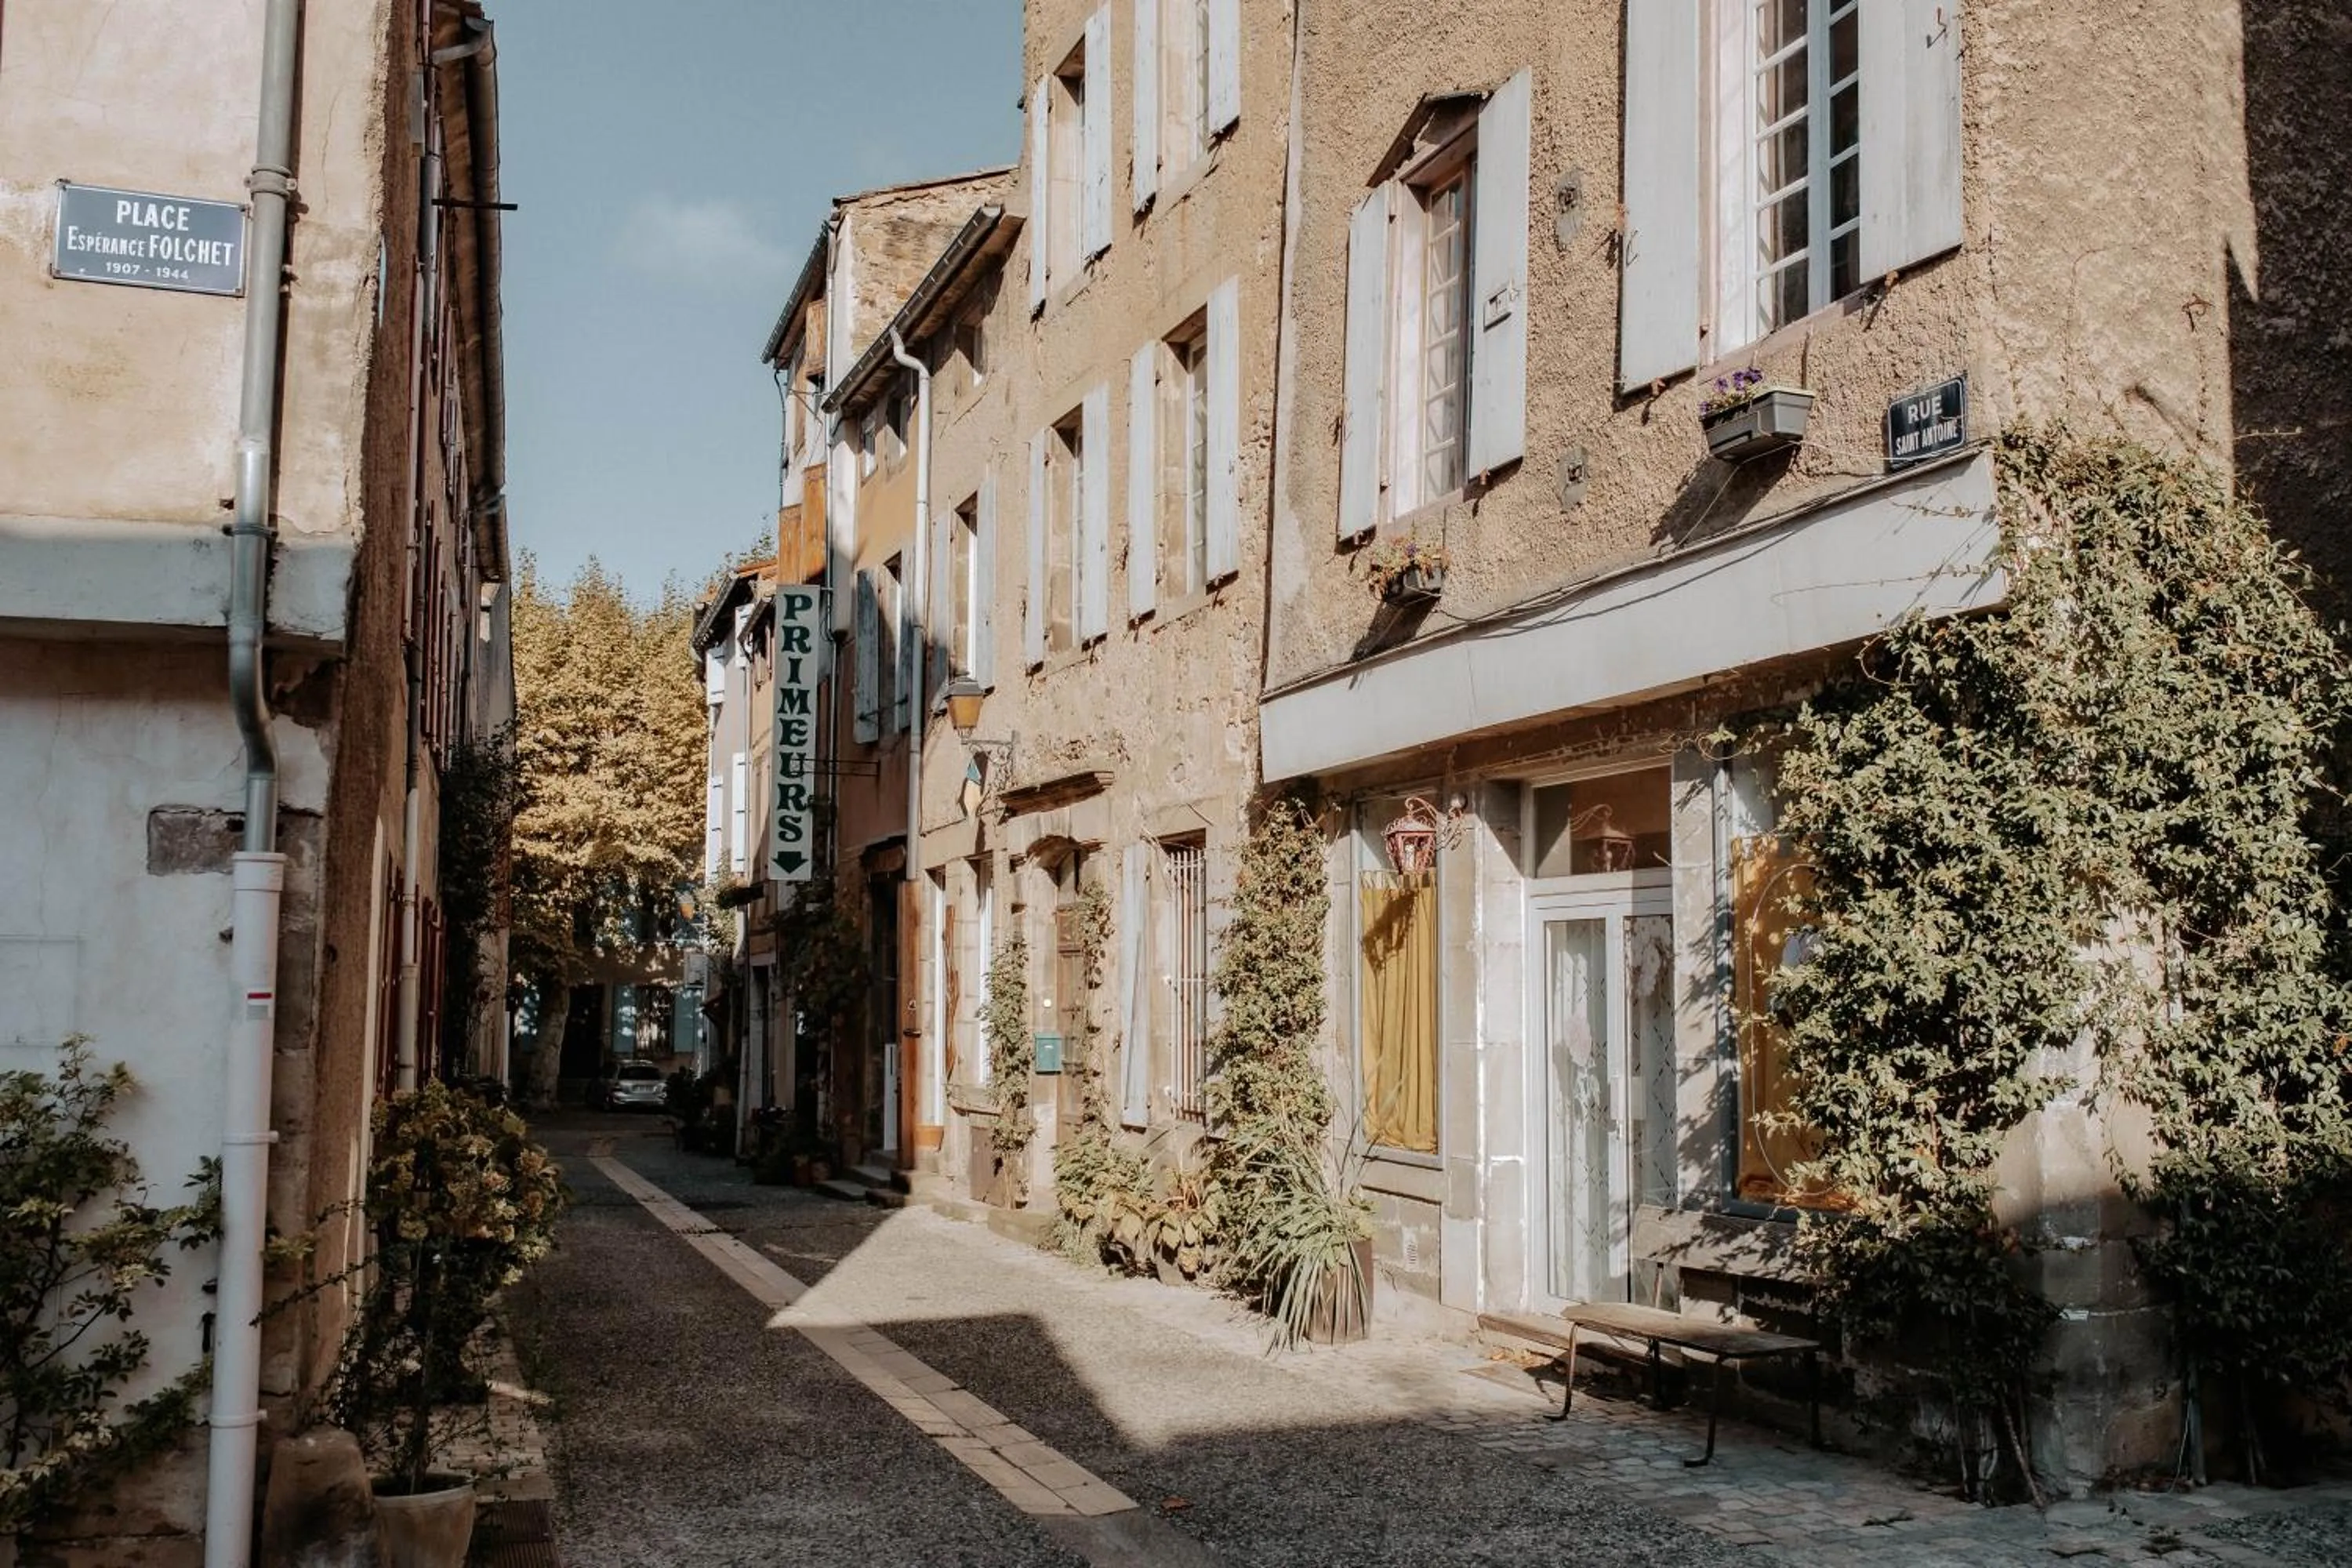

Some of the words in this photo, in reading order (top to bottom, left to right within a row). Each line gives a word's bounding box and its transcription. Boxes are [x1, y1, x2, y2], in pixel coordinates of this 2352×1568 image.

[116, 200, 191, 231] PLACE
[148, 234, 234, 267] FOLCHET
[106, 261, 140, 274] 1907
[157, 267, 189, 279] 1944
[1907, 394, 1942, 424] RUE
[1896, 431, 1919, 456] SAINT
[1921, 419, 1958, 448] ANTOINE
[777, 593, 812, 842] PRIMEURS
